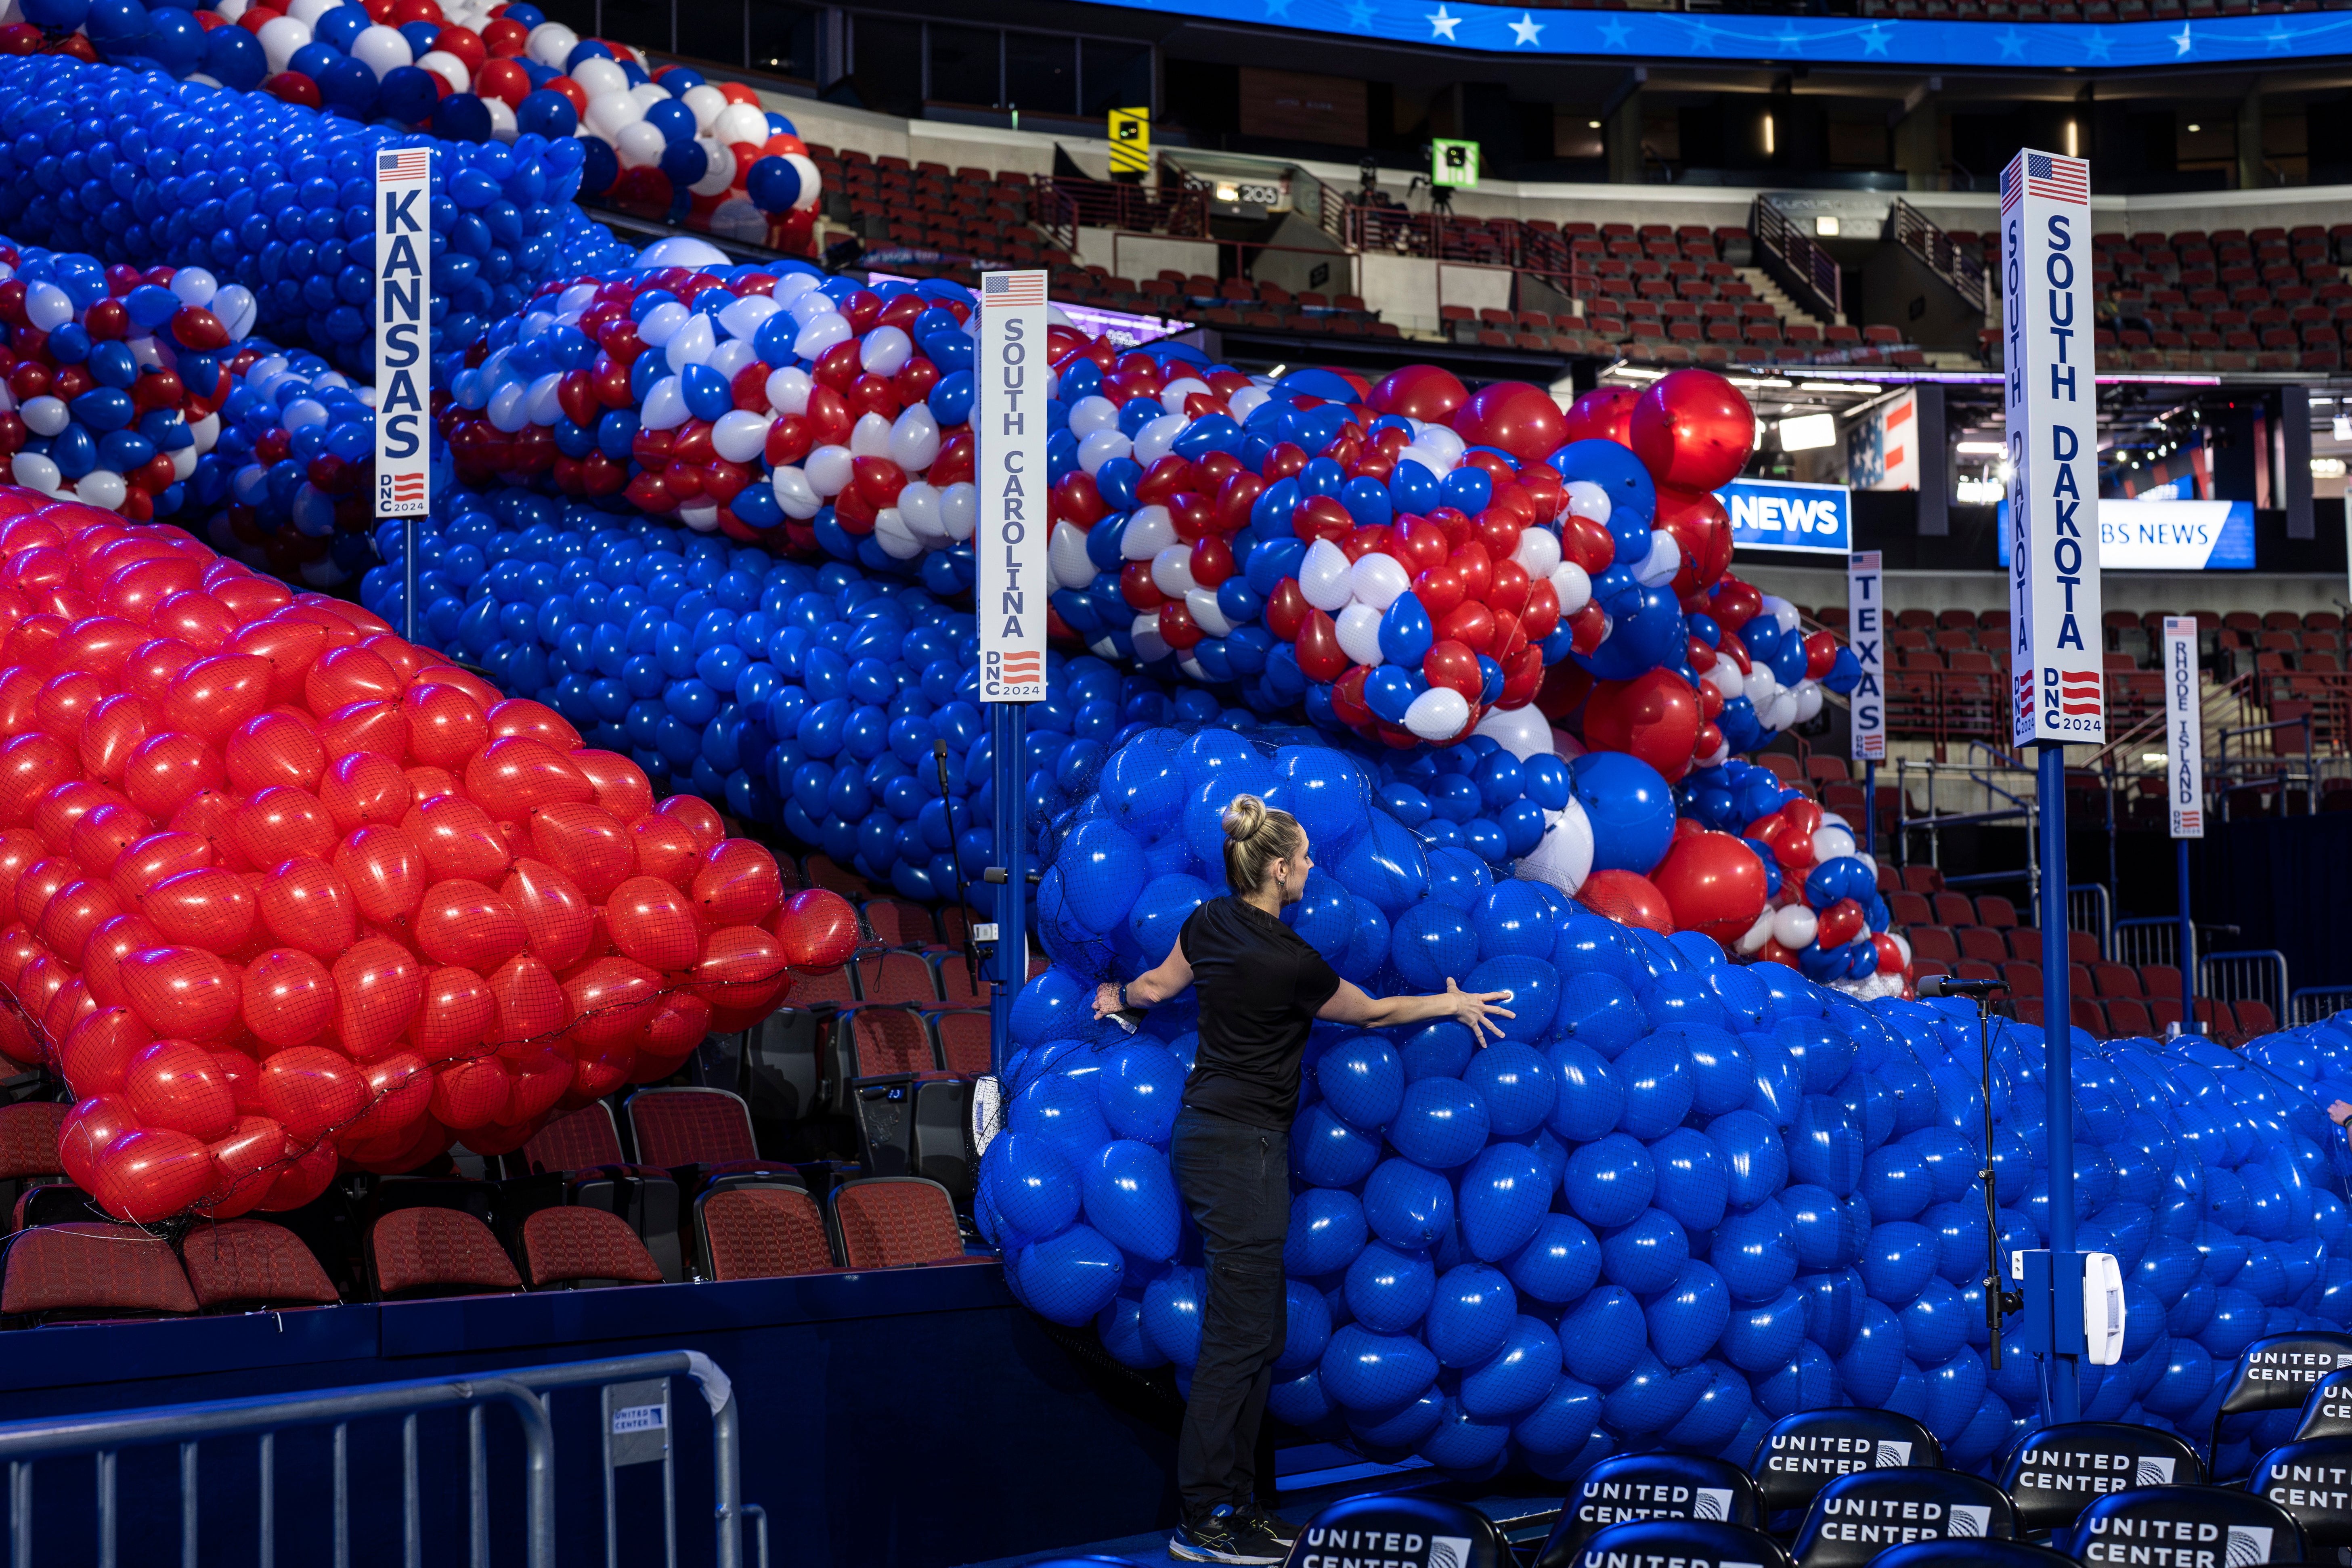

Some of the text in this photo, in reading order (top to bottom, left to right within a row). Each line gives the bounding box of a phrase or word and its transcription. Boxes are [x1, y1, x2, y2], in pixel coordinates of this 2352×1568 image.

[382, 189, 422, 459] KANSAS
[2008, 220, 2028, 655] SOUTH DAKOTA
[2046, 215, 2084, 650] SOUTH DAKOTA
[1002, 319, 1025, 637] SOUTH CAROLINA
[380, 474, 392, 512] DNC
[394, 503, 424, 511] 2024
[1732, 495, 1838, 535] NEWS
[2102, 524, 2130, 544] BS
[2140, 524, 2208, 545] NEWS
[1855, 576, 1880, 729] TEXAS
[986, 651, 1000, 696] DNC
[1003, 686, 1040, 695] 2024
[2044, 667, 2060, 729] DNC
[2021, 717, 2034, 734] 2024
[2063, 718, 2101, 732] 2024
[2176, 641, 2192, 804] RHODE ISLAND
[2249, 1353, 2331, 1365] UNITED
[615, 1409, 648, 1419] UNITED
[615, 1419, 648, 1429] CENTER
[1771, 1436, 1870, 1453] UNITED
[2022, 1450, 2130, 1470] UNITED
[2019, 1472, 2126, 1493] CENTER
[2271, 1465, 2352, 1484] UNIT
[1583, 1483, 1689, 1503] UNITED
[2270, 1488, 2352, 1509] CENT
[1824, 1499, 1941, 1520] UNITED
[2090, 1518, 2218, 1541] UNITED
[1308, 1528, 1423, 1553] UNITED
[2087, 1543, 2215, 1568] CENTER
